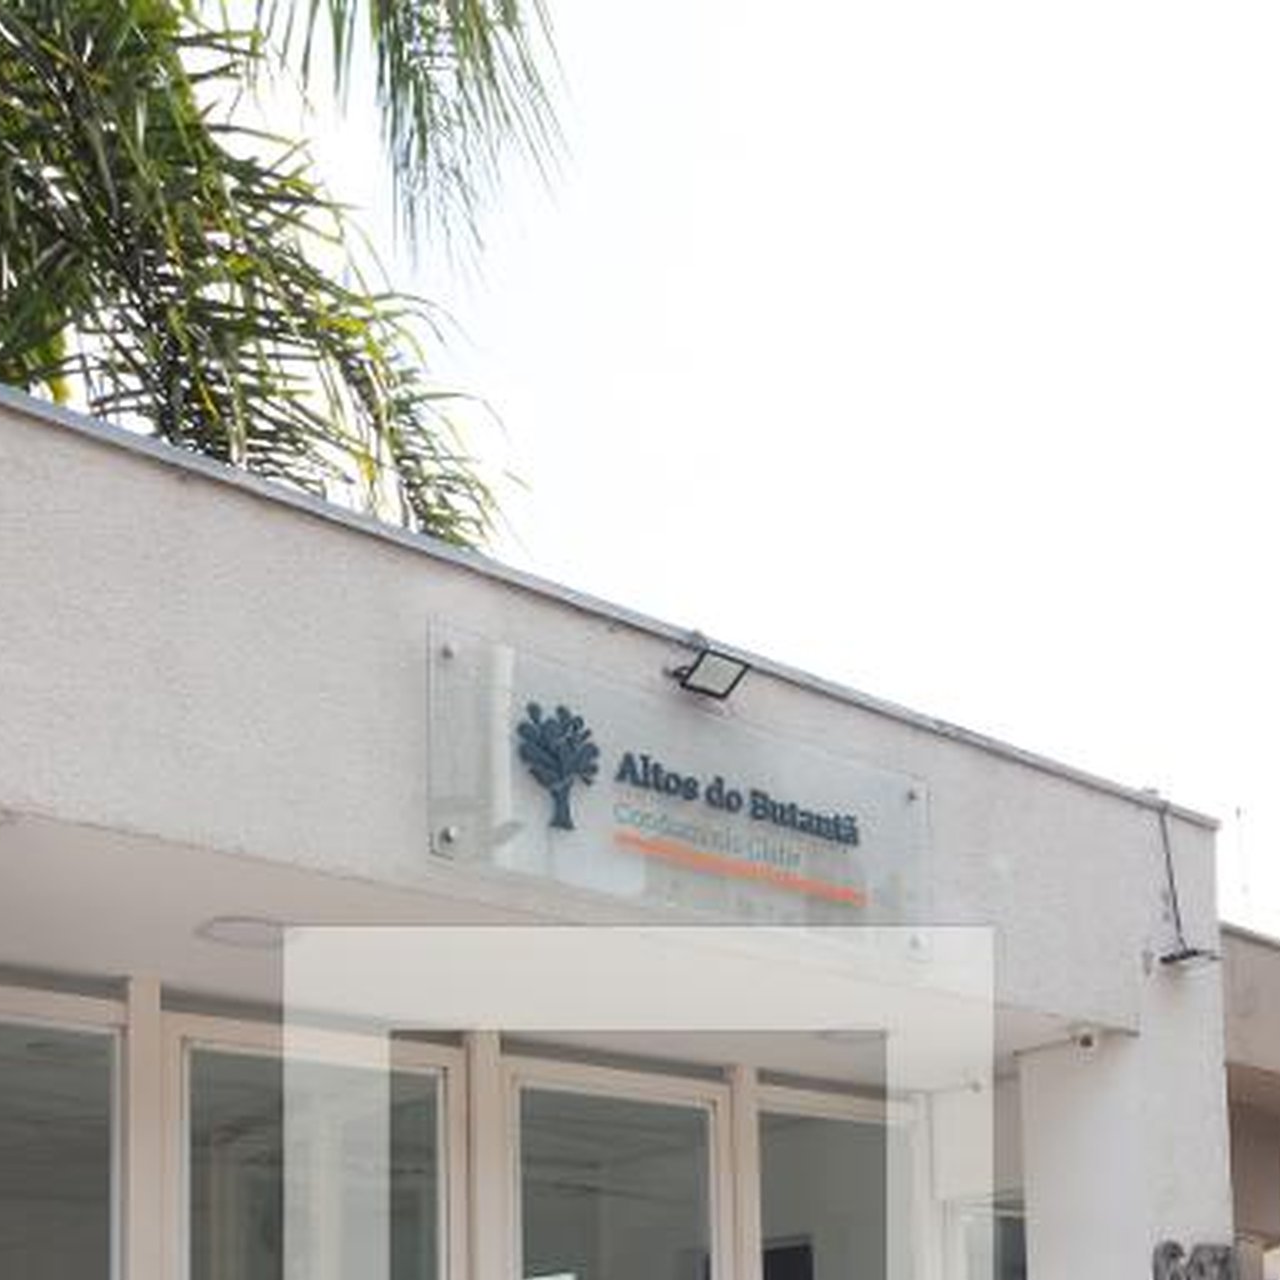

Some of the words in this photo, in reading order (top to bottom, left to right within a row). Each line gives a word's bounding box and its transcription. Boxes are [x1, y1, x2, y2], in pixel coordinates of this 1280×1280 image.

[615, 752, 699, 801] Altos
[705, 776, 743, 813] do
[750, 788, 859, 846] Butantã
